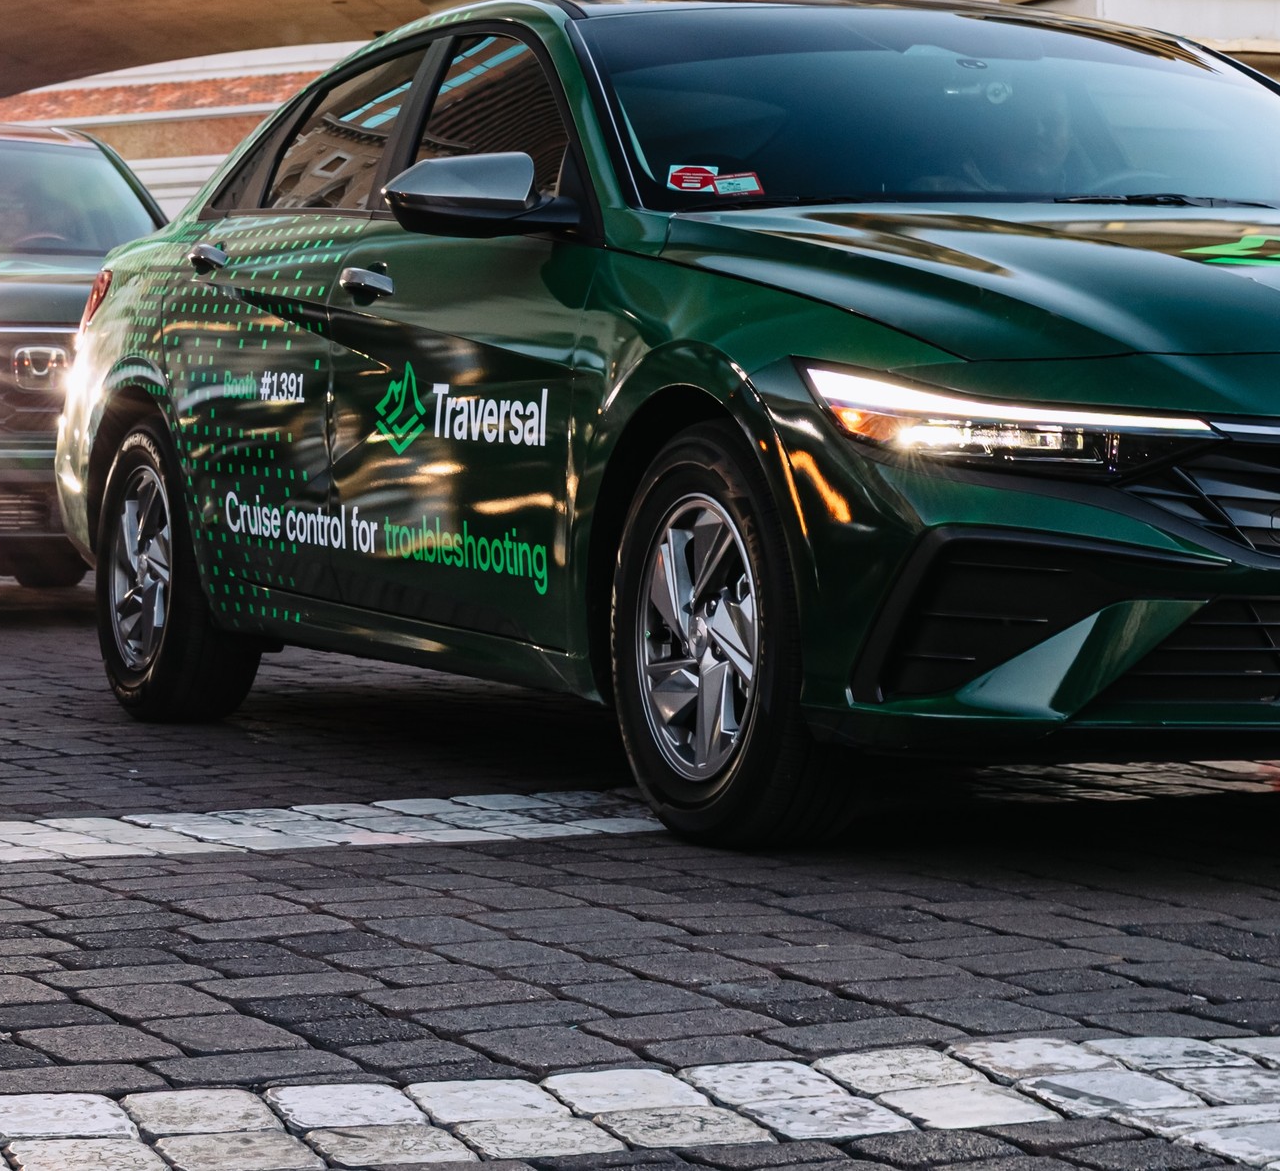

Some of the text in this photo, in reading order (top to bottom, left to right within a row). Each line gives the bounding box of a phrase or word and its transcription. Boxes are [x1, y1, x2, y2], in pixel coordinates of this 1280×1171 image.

[223, 370, 305, 403] Booth #1391
[432, 382, 549, 447] Traversal
[225, 491, 548, 596] Cruise control for troubleshooting
